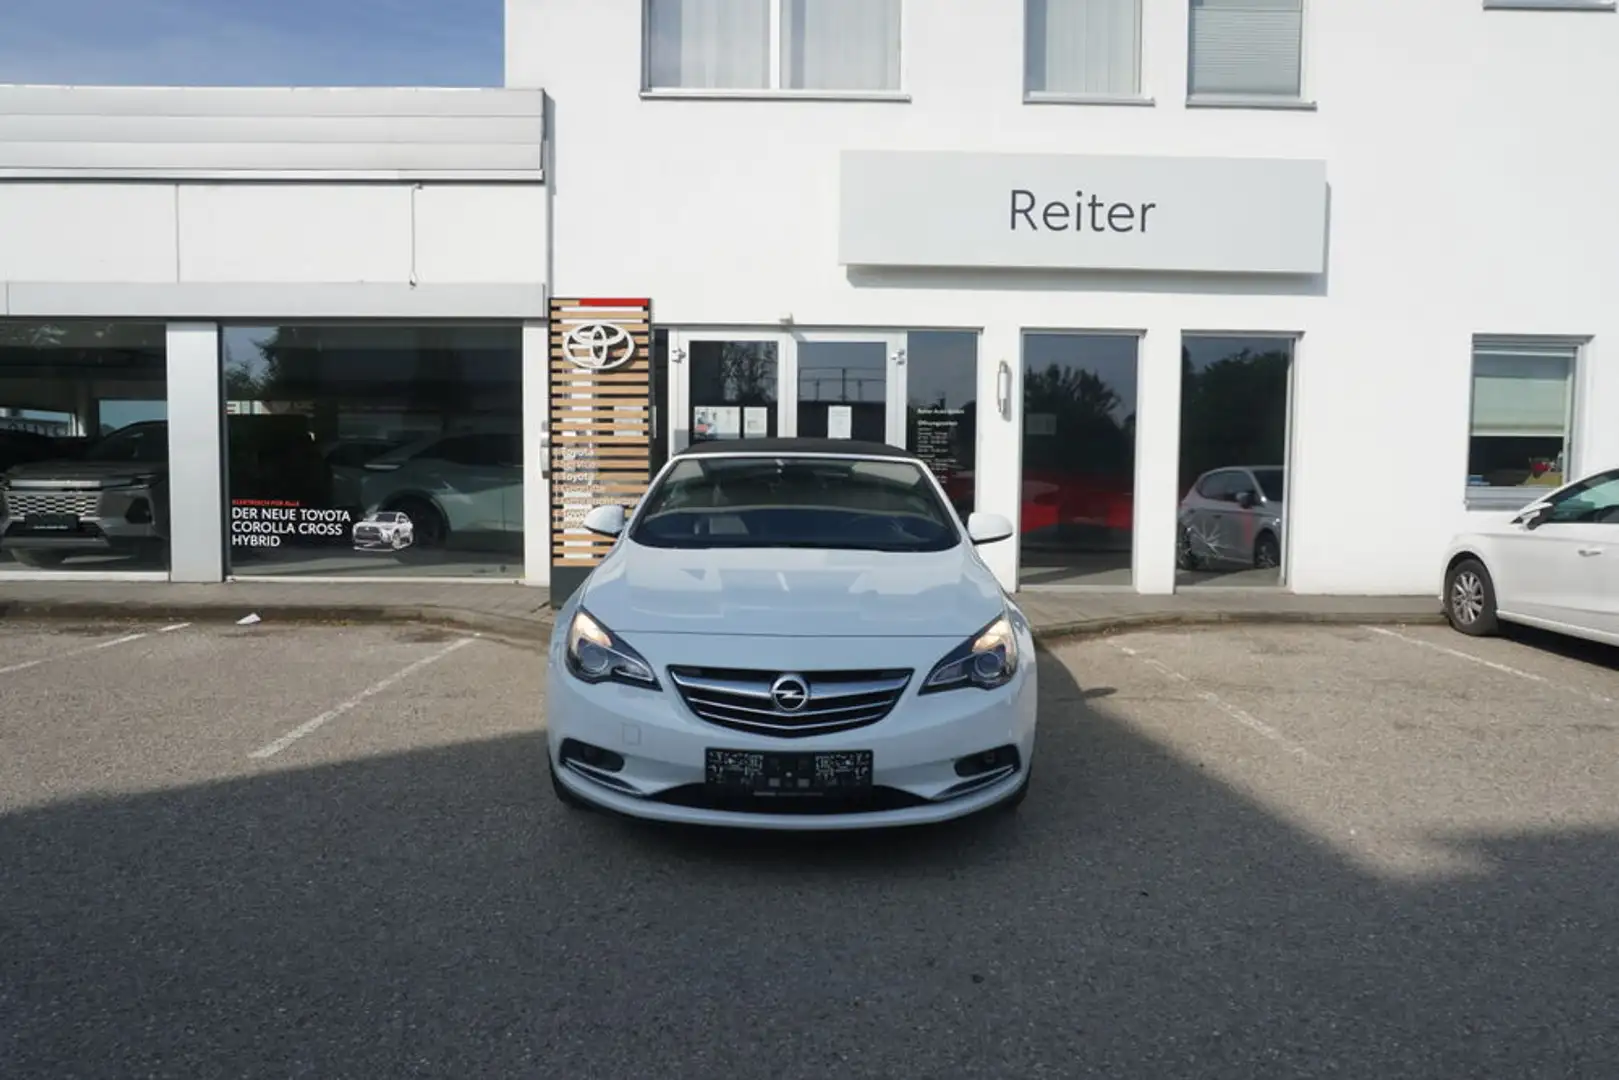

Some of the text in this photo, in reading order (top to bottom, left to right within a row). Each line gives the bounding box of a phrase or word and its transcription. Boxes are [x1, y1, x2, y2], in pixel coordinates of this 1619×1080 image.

[1010, 189, 1156, 233] Reiter
[232, 507, 351, 522] DER NEUE TOYOTA
[232, 521, 343, 536] COROLLA CROSS
[232, 535, 281, 547] HYBRID
